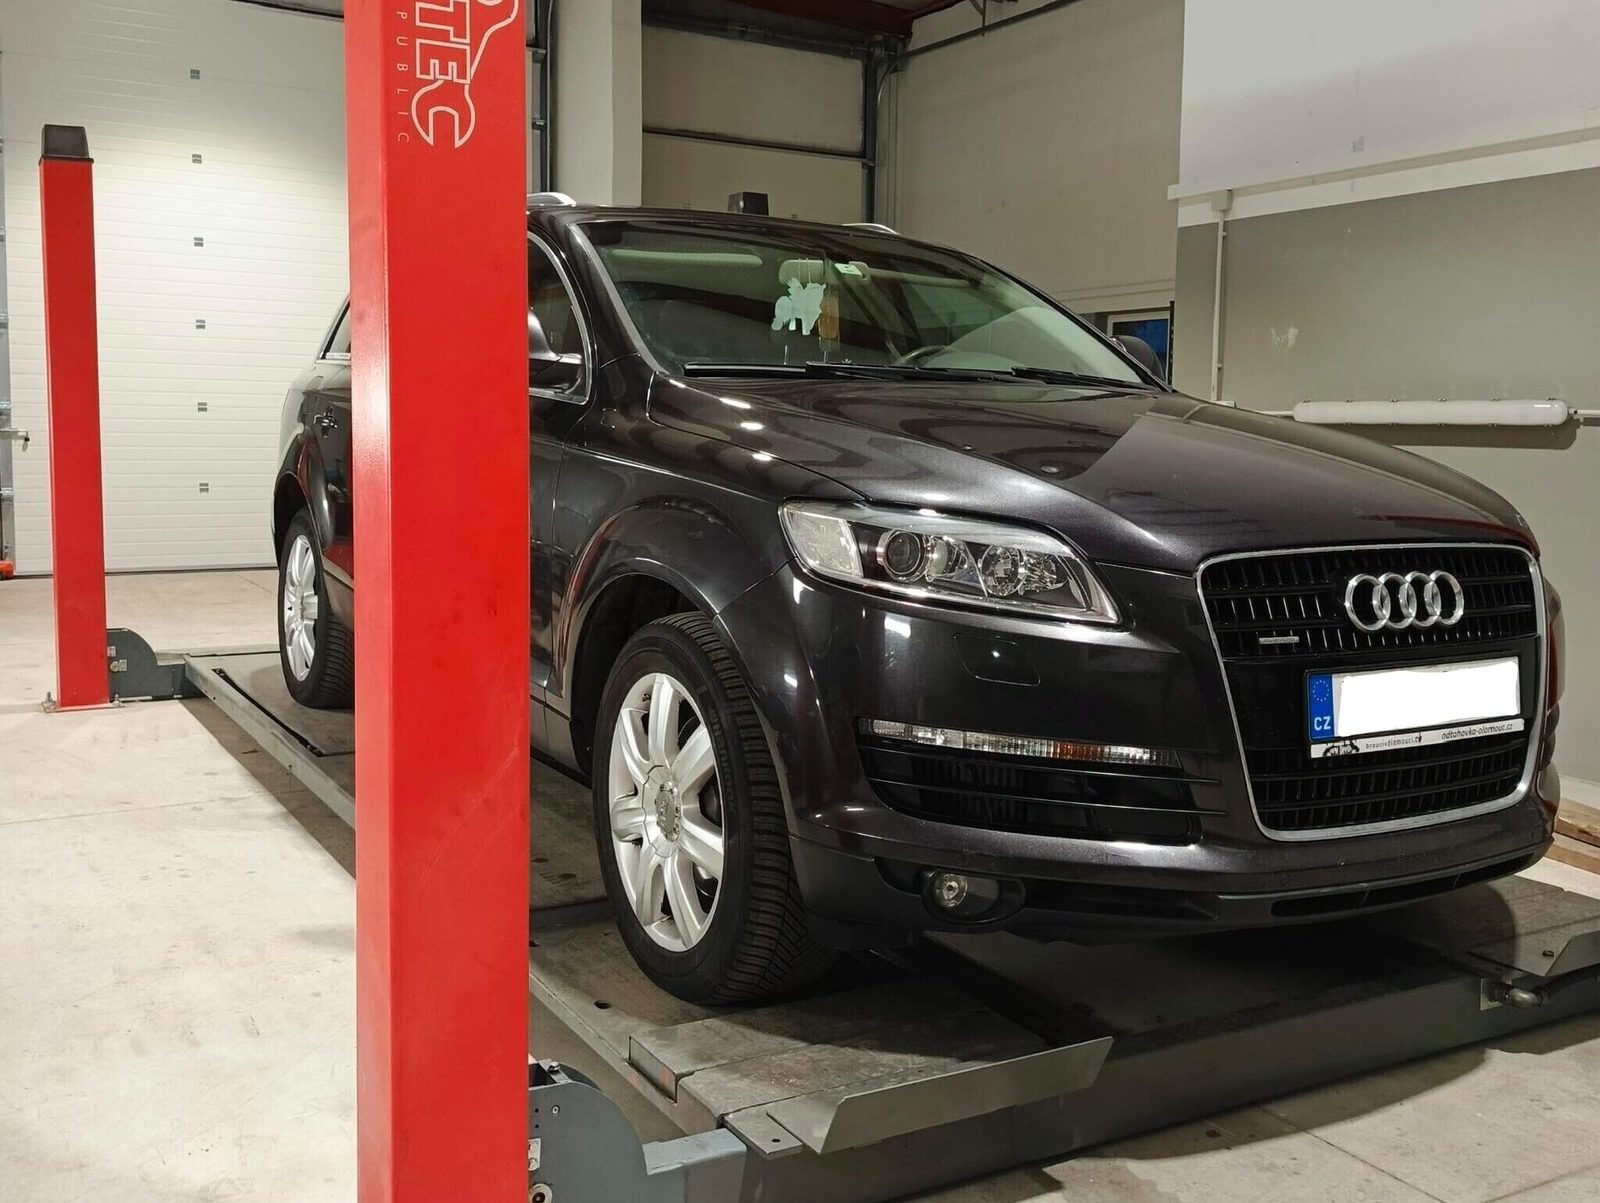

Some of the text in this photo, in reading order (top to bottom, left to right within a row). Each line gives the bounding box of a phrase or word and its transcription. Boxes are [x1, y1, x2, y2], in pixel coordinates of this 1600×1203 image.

[396, 11, 409, 143] PUBLIC
[1314, 716, 1331, 731] CZ
[1441, 723, 1513, 740] odtahovka-olomouc.cz
